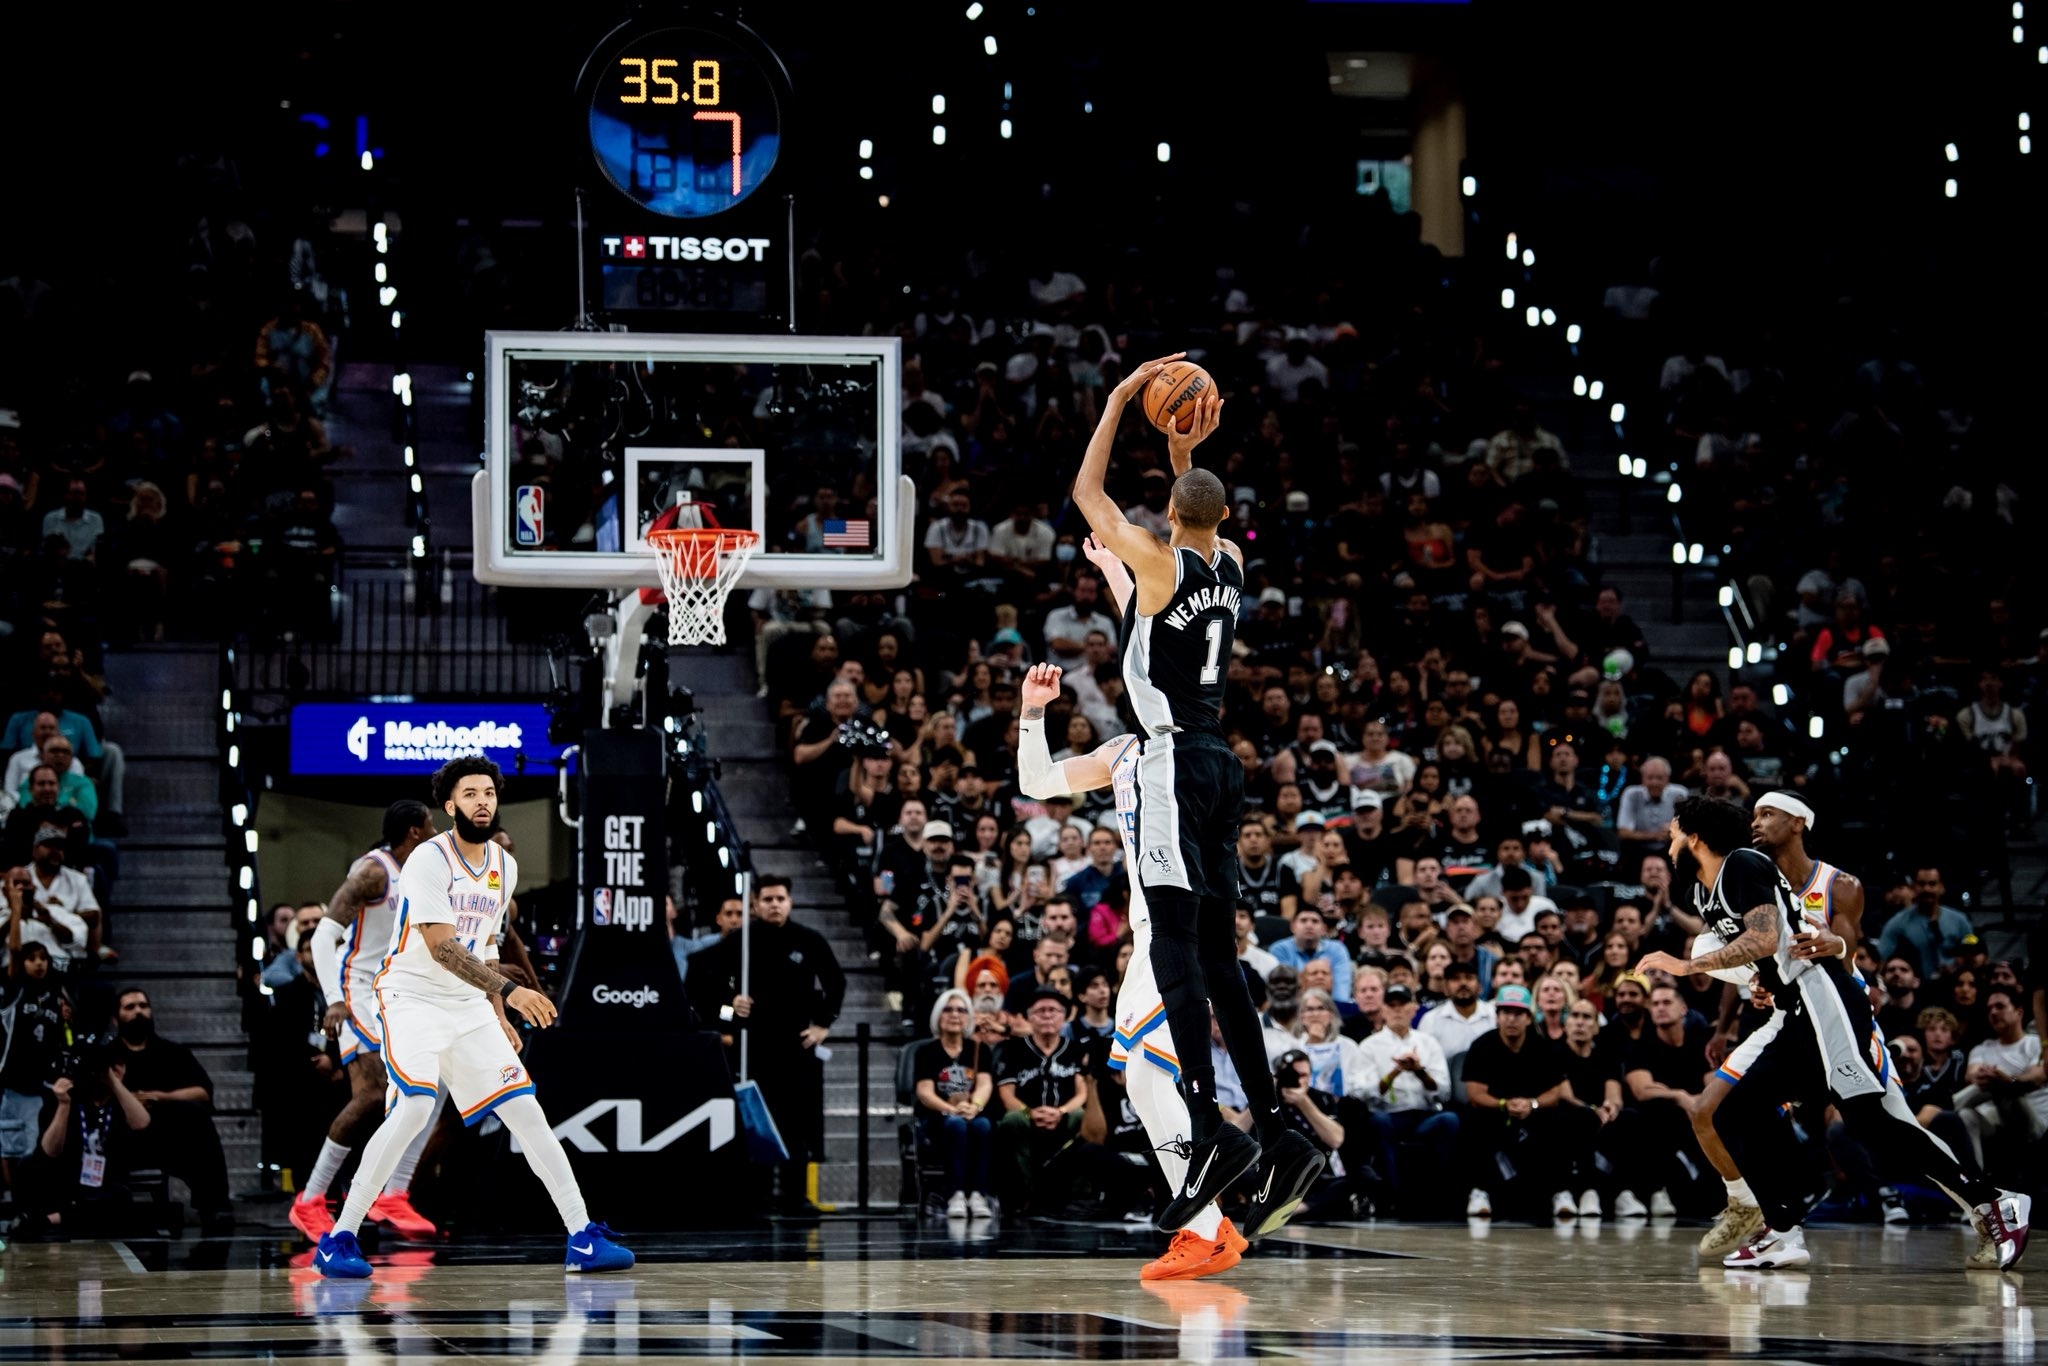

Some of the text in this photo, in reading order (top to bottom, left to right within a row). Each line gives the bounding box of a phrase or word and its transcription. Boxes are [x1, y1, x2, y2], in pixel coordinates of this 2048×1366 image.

[620, 58, 720, 105] 35.8
[693, 111, 741, 196] 7
[648, 236, 770, 262] TISSOT
[1166, 376, 1207, 415] Wilson
[1200, 619, 1223, 685] 1
[384, 720, 523, 748] Methodist
[604, 815, 645, 850] GET
[604, 852, 645, 886] THE
[456, 916, 481, 934] CITY
[612, 888, 654, 932] App
[592, 984, 660, 1009] Google
[510, 1098, 735, 1153] KIA
